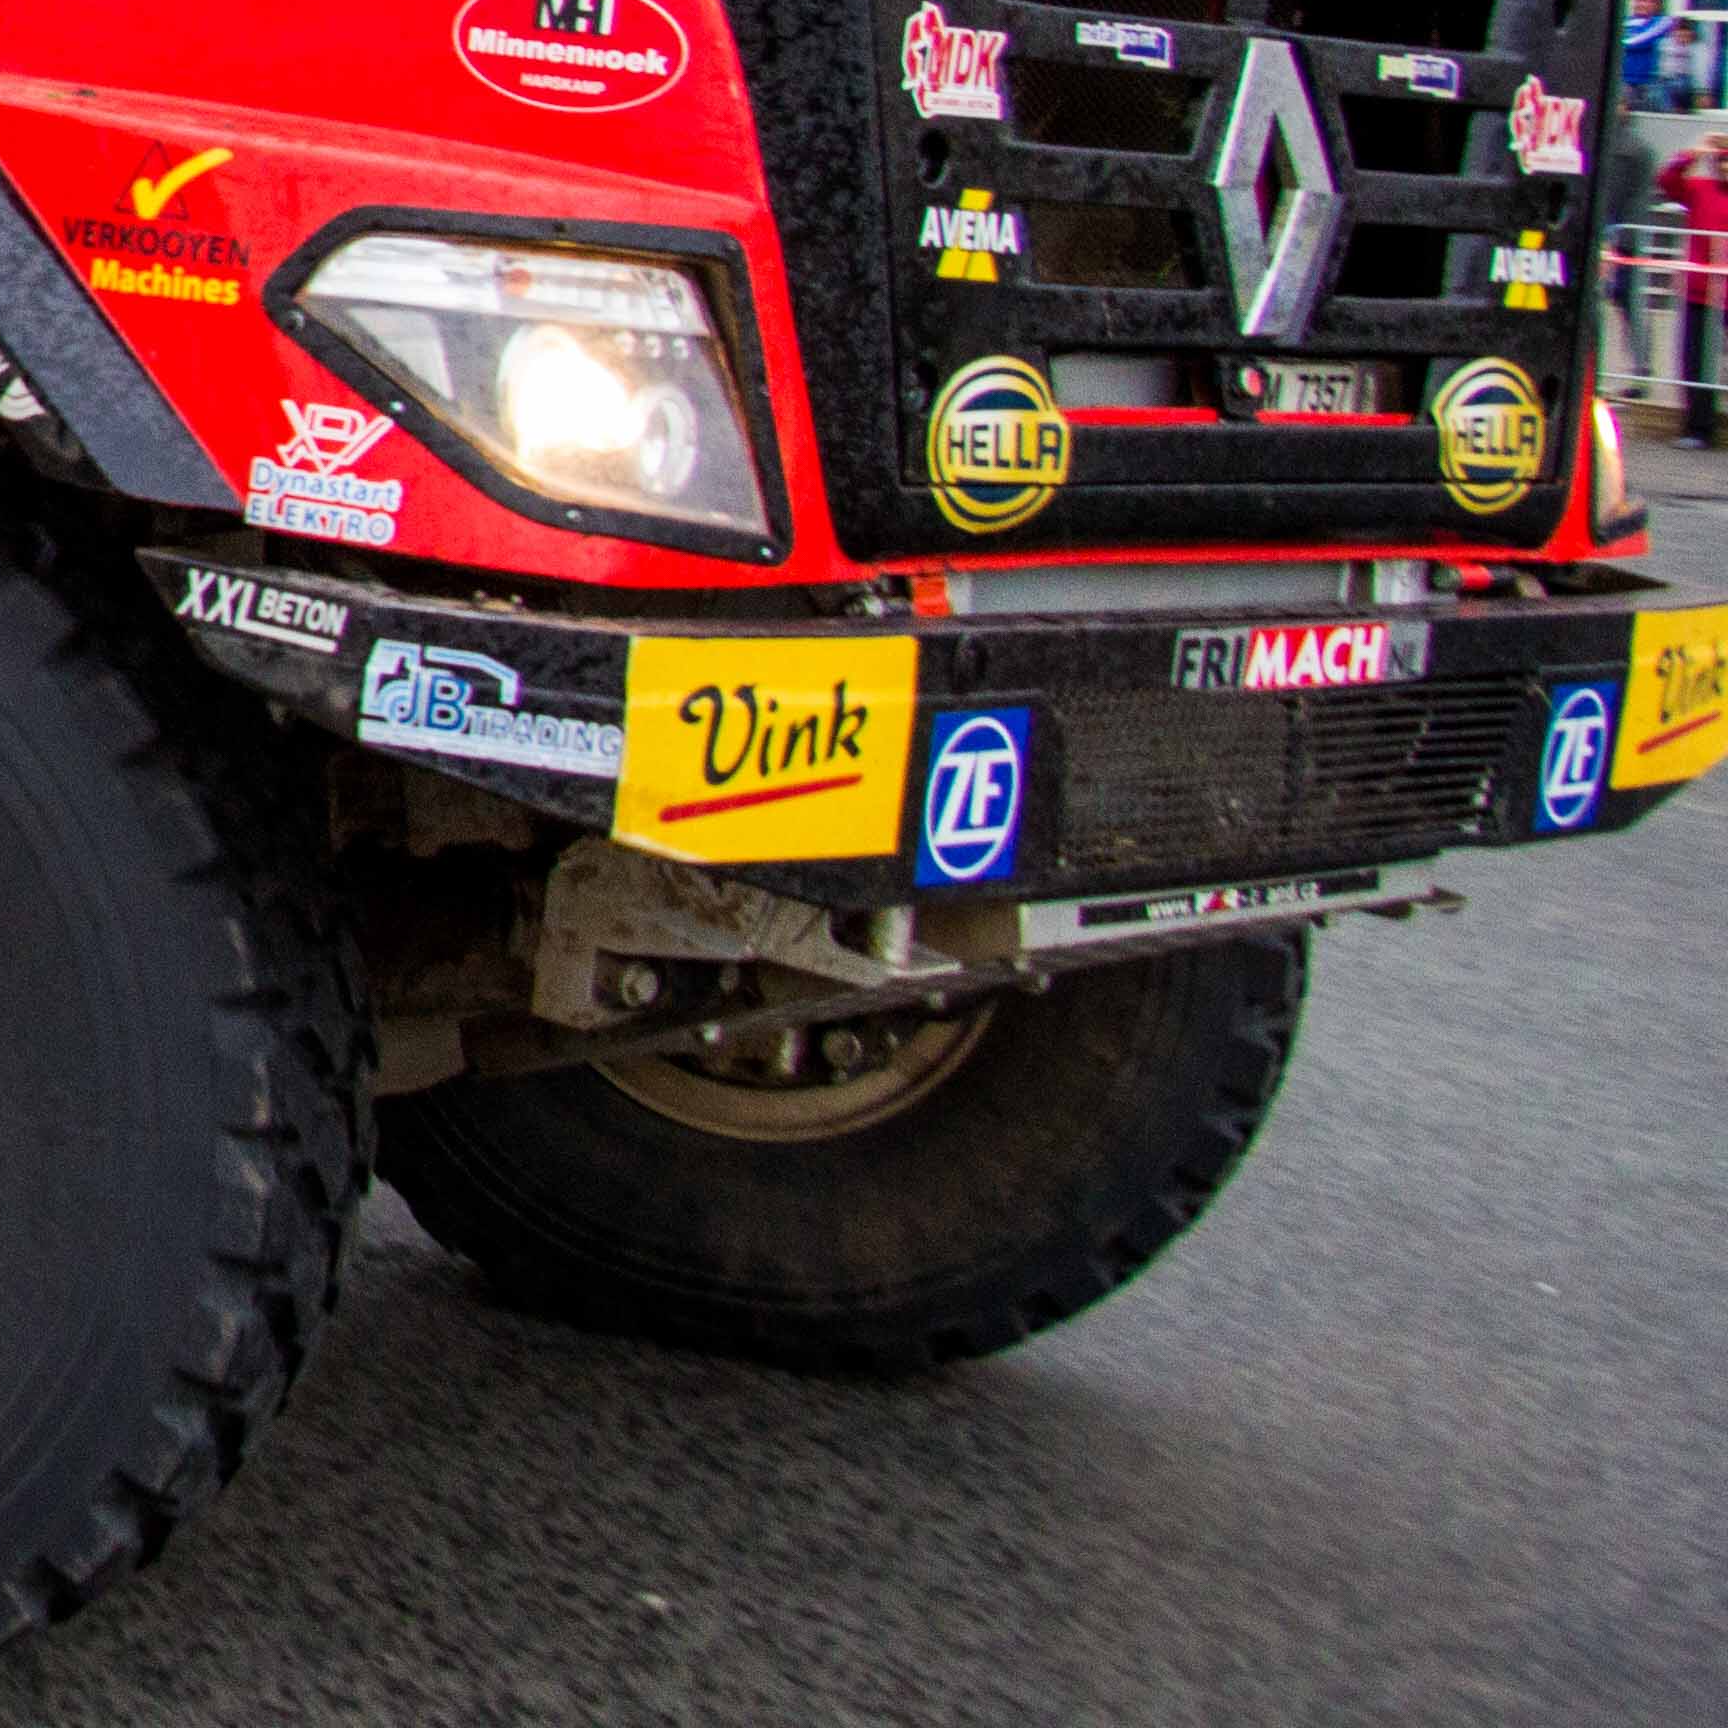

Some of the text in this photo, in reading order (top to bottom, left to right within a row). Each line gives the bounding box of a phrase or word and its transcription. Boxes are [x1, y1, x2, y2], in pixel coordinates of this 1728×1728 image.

[63, 216, 252, 267] VERKOOYEN
[919, 206, 1021, 255] AVEMA
[90, 257, 240, 306] Machines
[947, 423, 1063, 471] HELLA
[1451, 414, 1538, 458] HELLA
[253, 462, 402, 511] Dynastart
[246, 498, 394, 545] ELEKTRO
[176, 569, 347, 637] XXL BETON
[470, 709, 624, 758] TRADING
[679, 678, 868, 786] Vink
